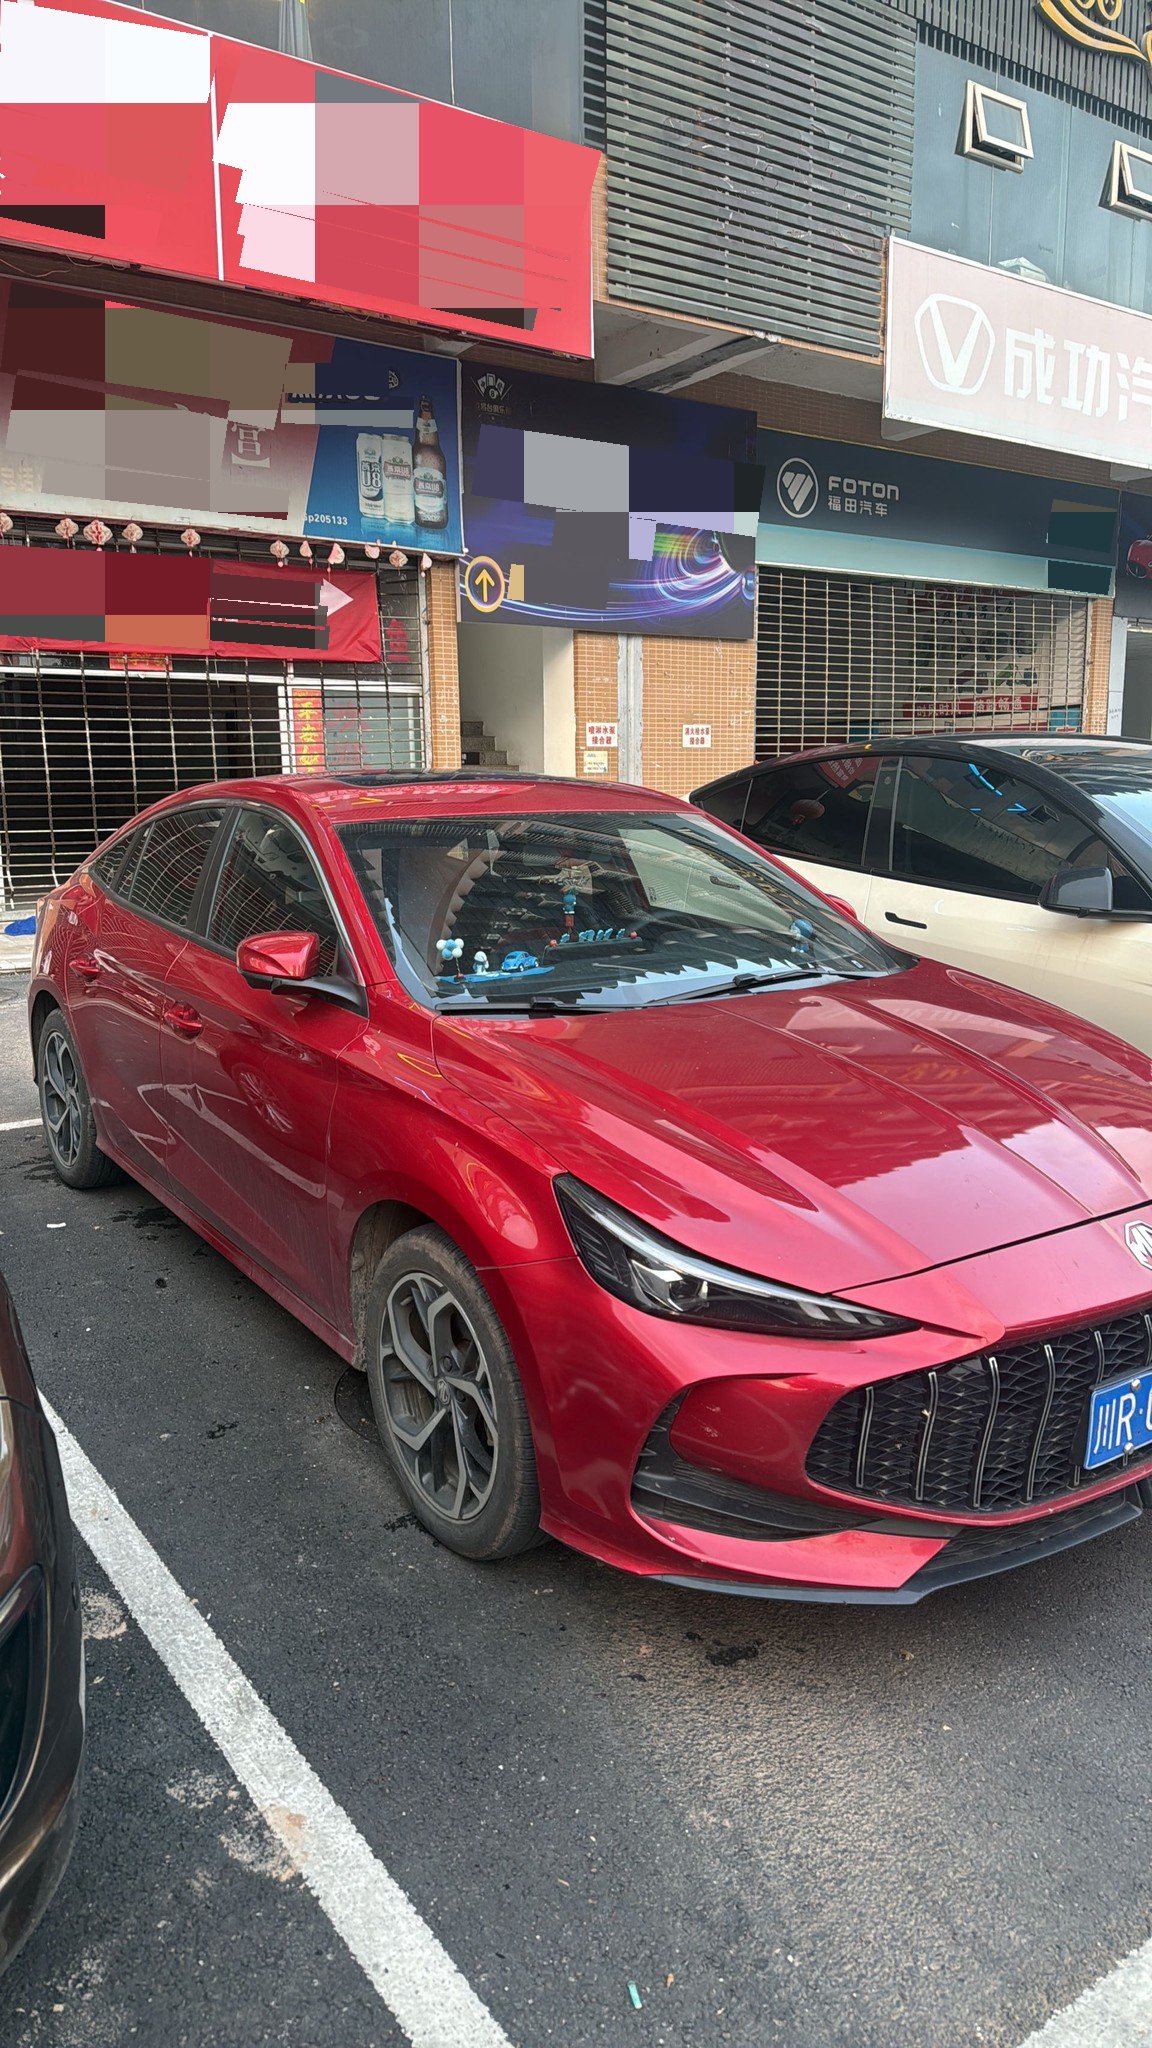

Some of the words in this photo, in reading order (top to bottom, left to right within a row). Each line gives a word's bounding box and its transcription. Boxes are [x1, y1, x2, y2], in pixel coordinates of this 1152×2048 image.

[828, 475, 901, 502] FOTON
[827, 495, 889, 518] 福田汽车
